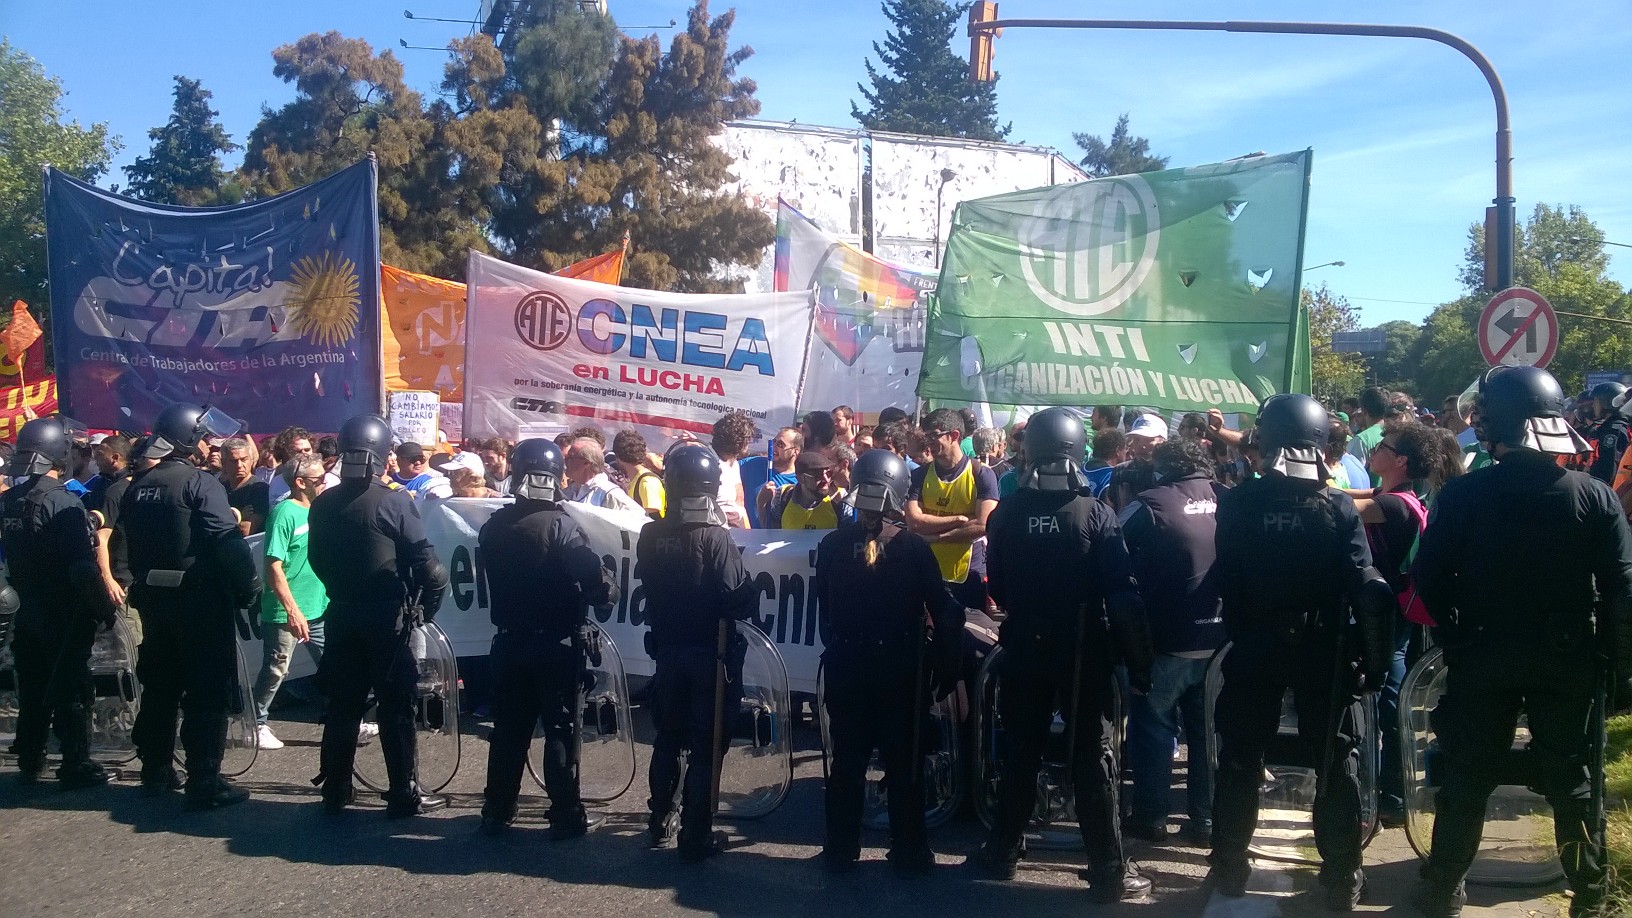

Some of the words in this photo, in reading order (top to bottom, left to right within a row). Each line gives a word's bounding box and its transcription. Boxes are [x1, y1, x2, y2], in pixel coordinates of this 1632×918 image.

[913, 276, 938, 290] FRENT
[518, 295, 567, 347] ATE
[576, 298, 776, 377] CNEA
[1043, 321, 1151, 362] INTI
[80, 347, 129, 364] Central
[130, 353, 148, 367] de
[149, 355, 237, 374] Trabajadores
[240, 356, 259, 369] de
[262, 354, 276, 367] la
[281, 350, 345, 368] Argentina
[572, 363, 609, 380] en
[619, 364, 725, 397] LUCHA
[1147, 370, 1167, 398] Y
[1169, 374, 1261, 407] LUCHA
[405, 393, 419, 401] NO
[509, 396, 562, 415] CTA
[514, 378, 528, 387] por
[530, 378, 539, 388] la
[541, 380, 582, 393] soberanía
[583, 386, 627, 398] energética
[628, 391, 635, 400] y
[635, 391, 644, 400] la
[645, 393, 688, 407] autonomía
[689, 399, 735, 414] tecnologica
[391, 401, 439, 411] CAMBIAMOS
[399, 411, 433, 419] SALARIO
[137, 487, 161, 502] PFA
[4, 517, 23, 530] PFA
[1028, 515, 1060, 534] PFA
[1263, 511, 1305, 532] PFA
[656, 537, 683, 553] PFA
[853, 541, 886, 559] PA
